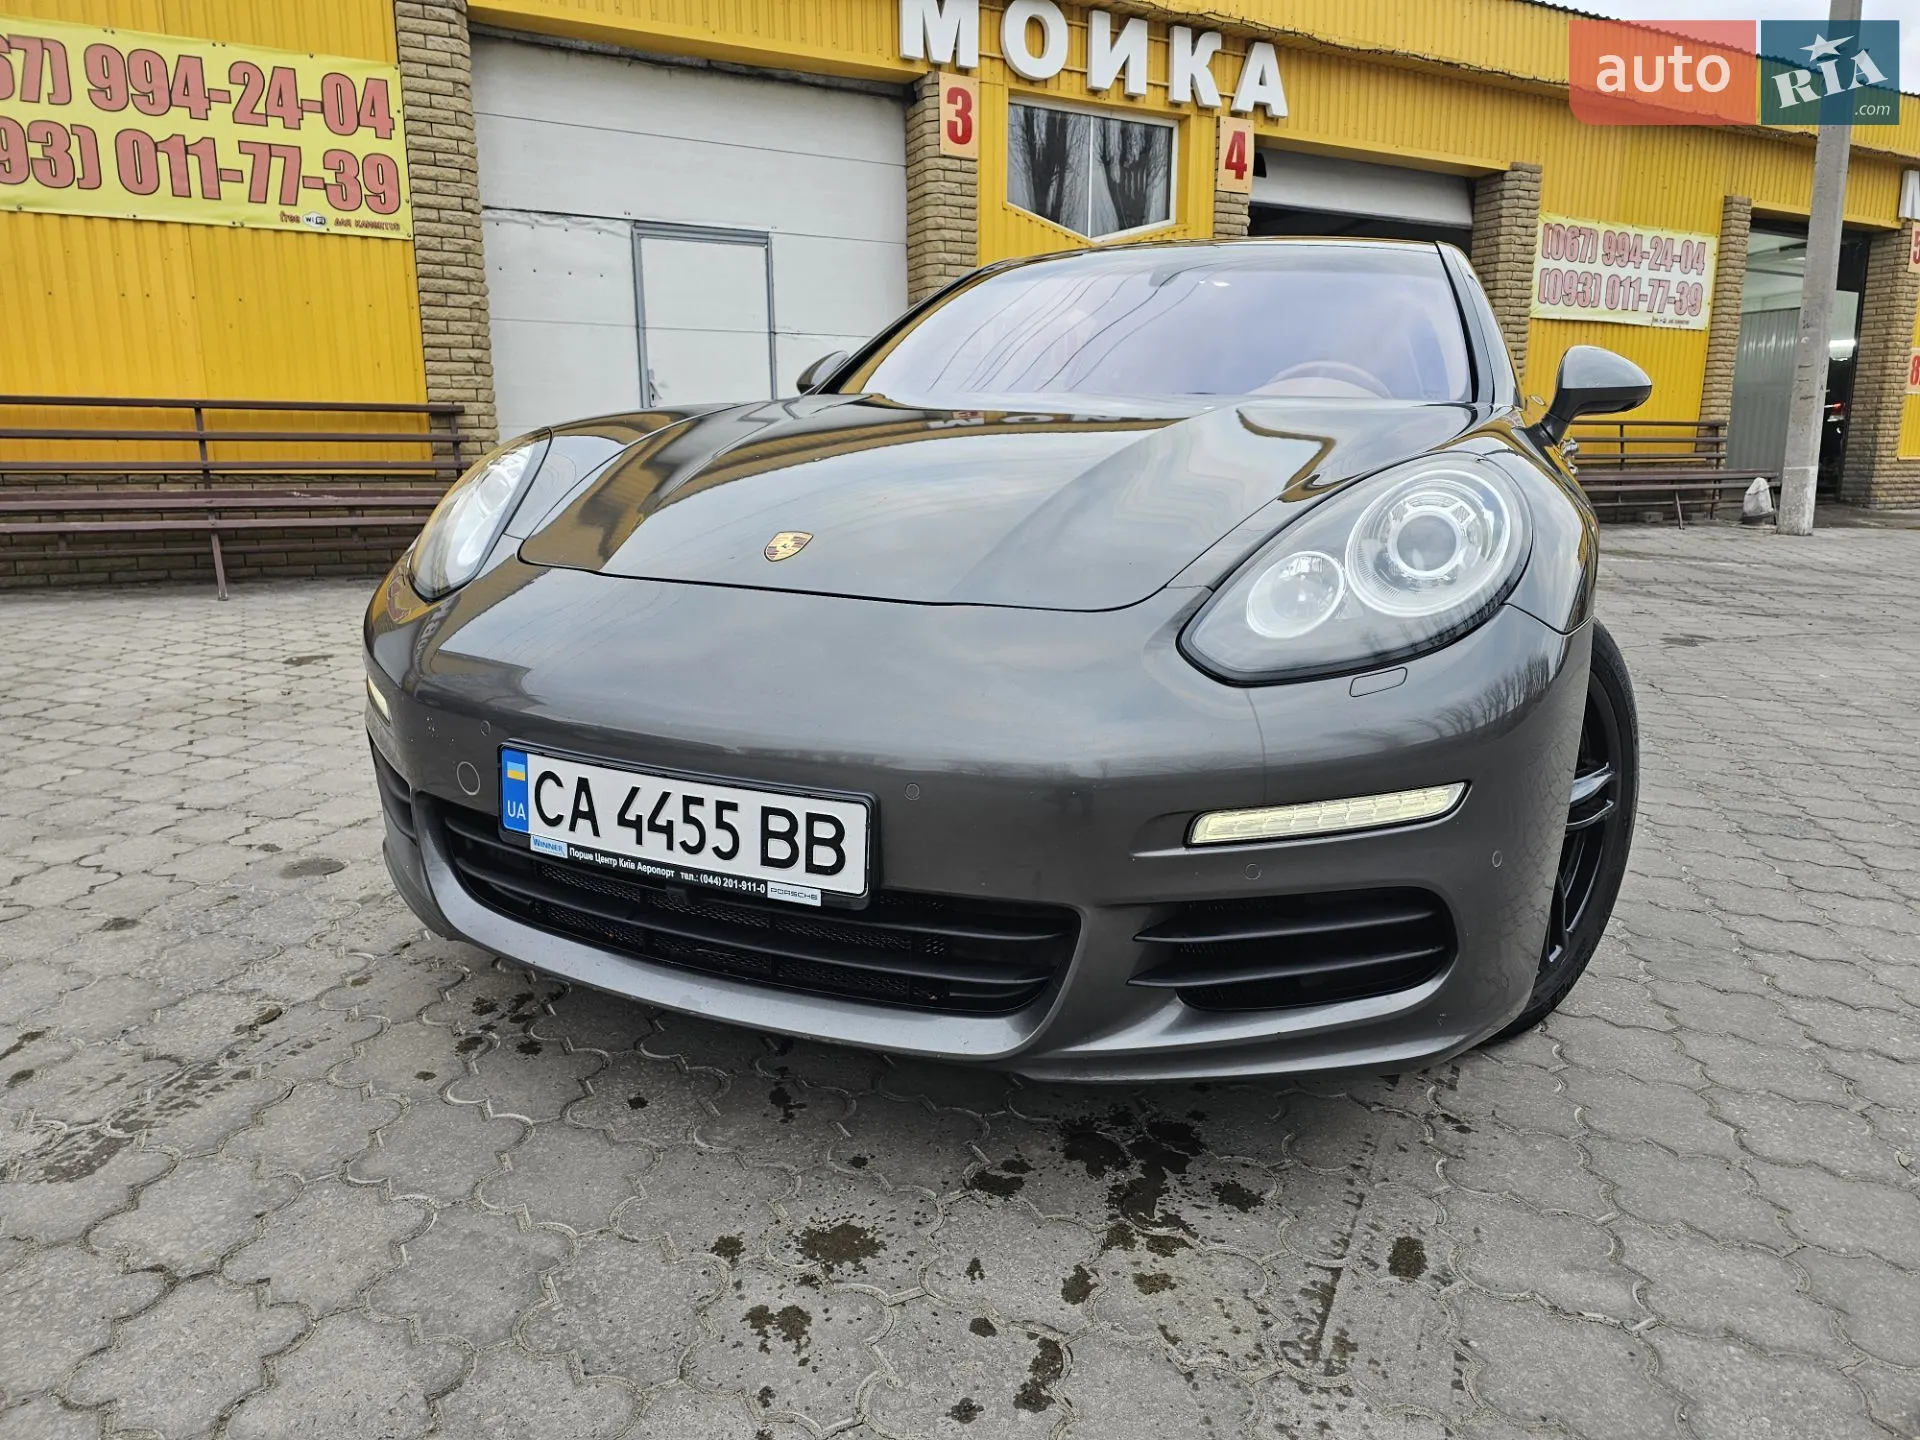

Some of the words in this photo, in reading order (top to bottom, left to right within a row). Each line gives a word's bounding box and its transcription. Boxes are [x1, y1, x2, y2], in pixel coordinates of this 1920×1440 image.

[84, 43, 395, 140] 994-24-04
[946, 86, 973, 145] 3
[115, 129, 401, 214] 011-77-39
[1224, 131, 1247, 180] 4
[1542, 223, 1598, 264] (067)
[1602, 230, 1706, 276] 994-24-04
[1538, 268, 1602, 308] (093)
[1605, 274, 1703, 316] 011-77-39
[507, 800, 526, 821] UA
[534, 770, 600, 838] CA
[617, 786, 740, 861] 4455
[760, 805, 846, 876] BB
[569, 847, 593, 861] Порше
[595, 852, 617, 867] Центр
[619, 858, 636, 870] Київ
[637, 862, 675, 878] Аеропорт
[700, 874, 721, 887] (044)
[723, 877, 766, 894] 201-911-0
[771, 887, 818, 900] PORSCHE
